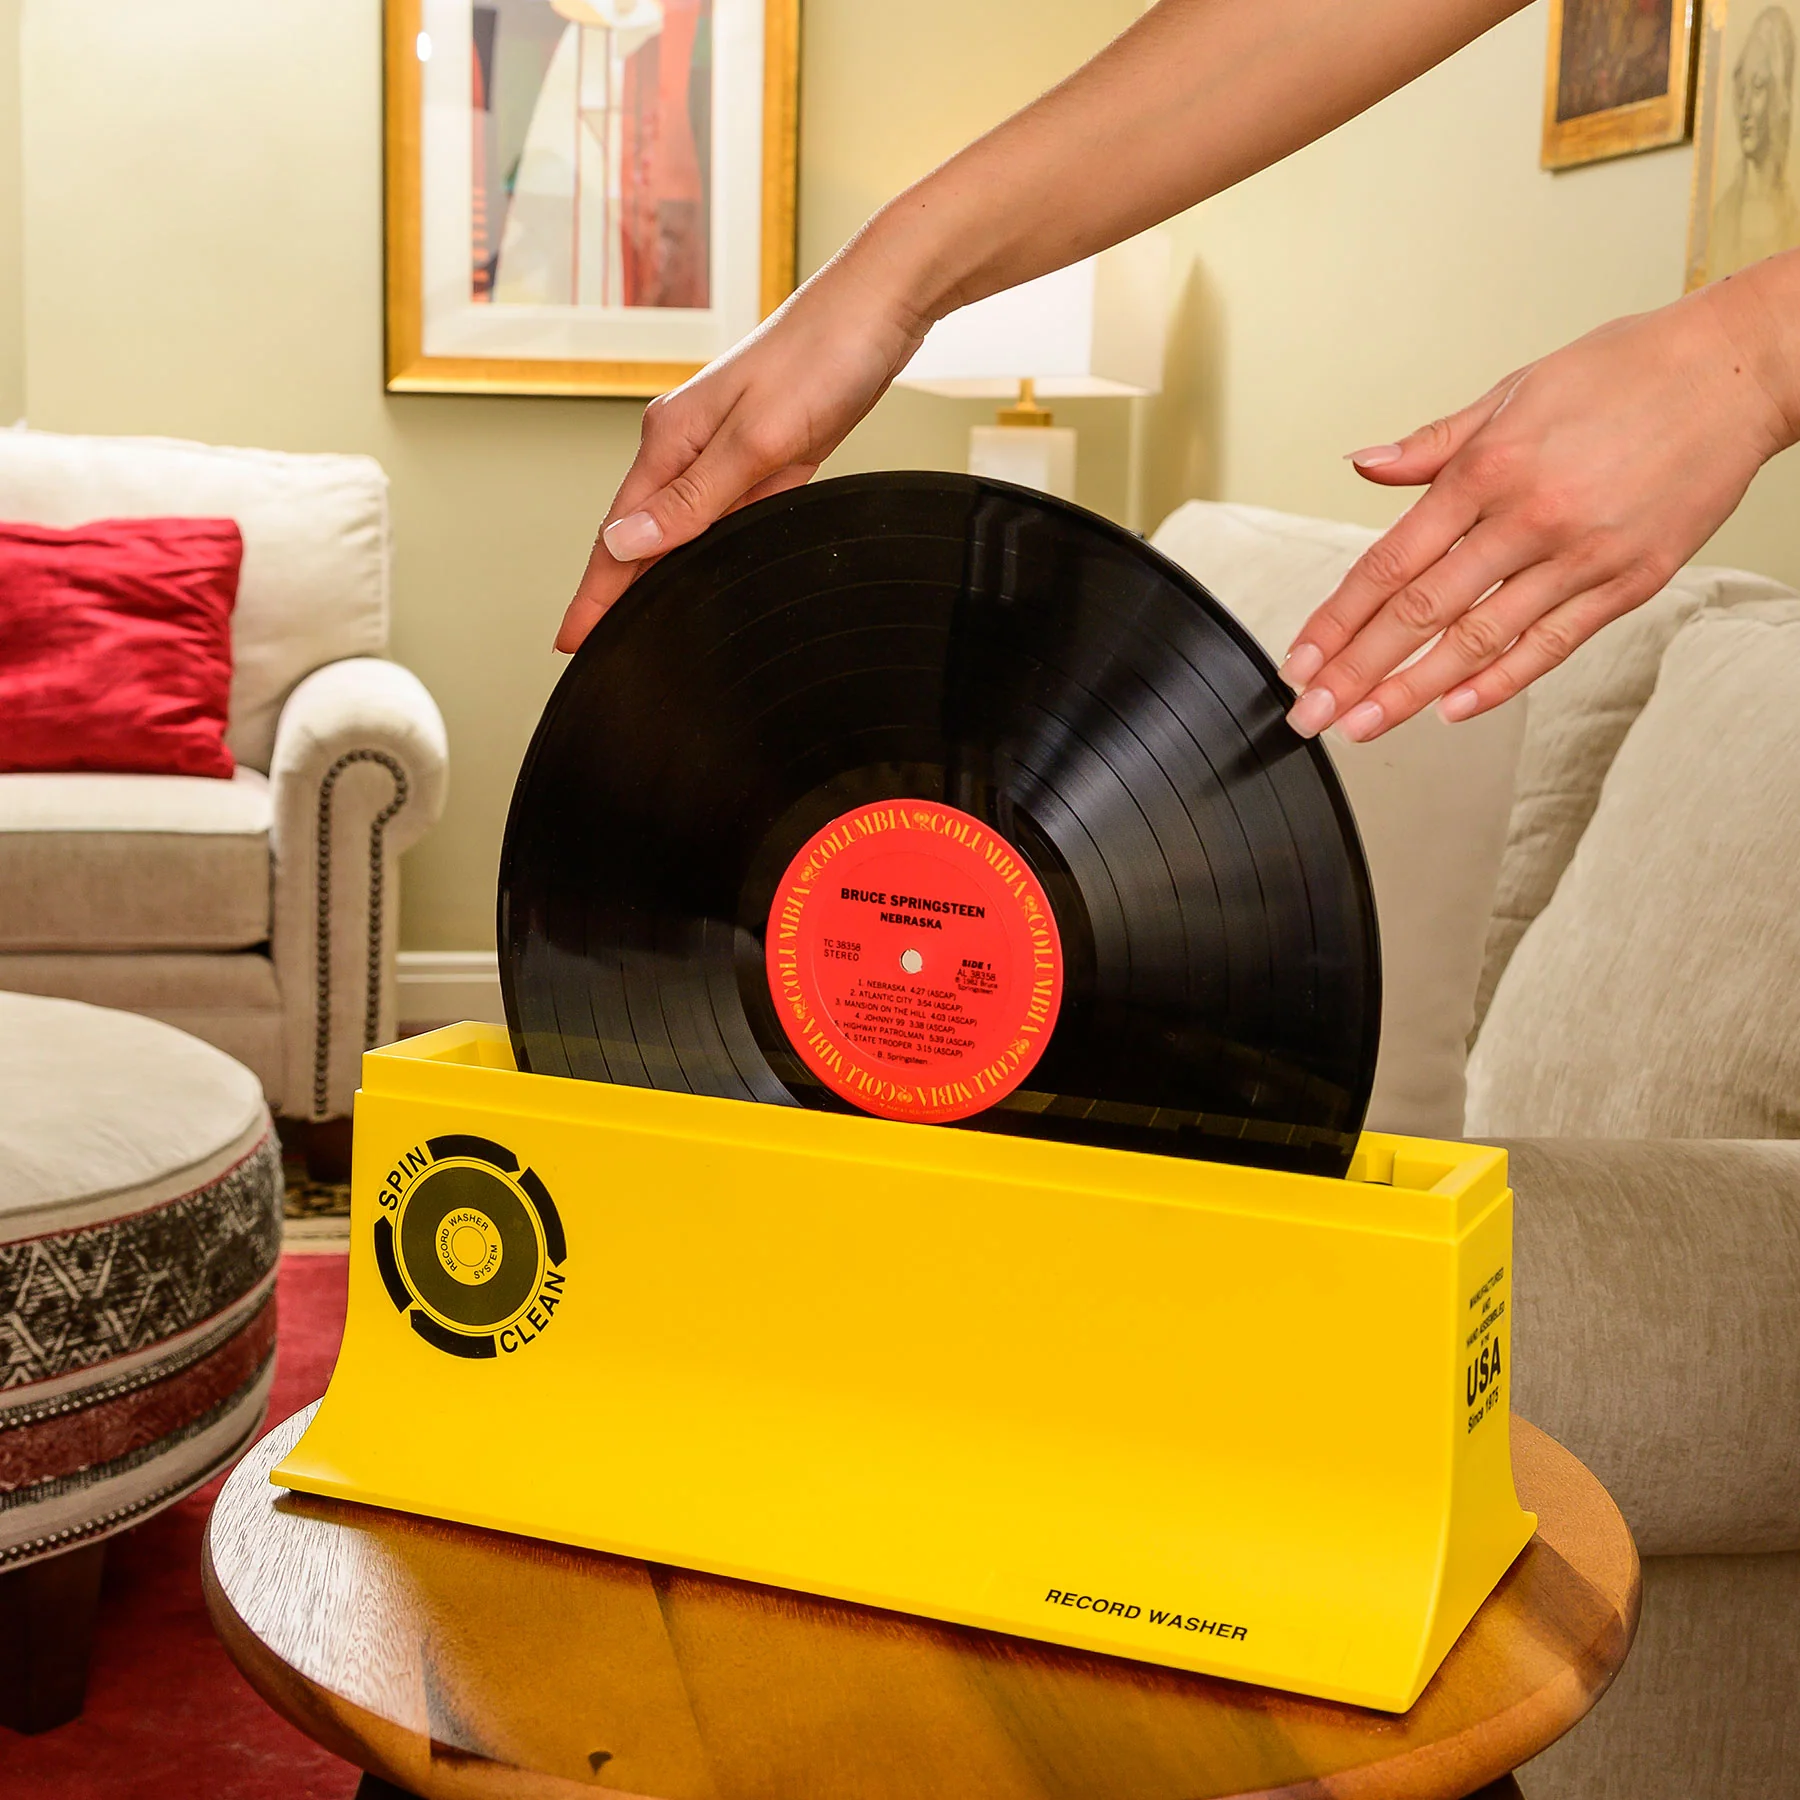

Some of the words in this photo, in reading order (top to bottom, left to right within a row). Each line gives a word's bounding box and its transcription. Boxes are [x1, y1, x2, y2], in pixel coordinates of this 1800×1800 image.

[810, 808, 911, 870] COLUMBIA
[930, 813, 1028, 898] COLUMBIA
[841, 887, 886, 904] BRUCE
[890, 894, 985, 918] SPRINGSTEEN
[880, 912, 942, 930] NEBRASKA
[778, 886, 810, 1002] COLUMBIA
[824, 938, 834, 948] TC
[836, 940, 861, 952] 38358
[824, 949, 860, 962] STEREO
[957, 969, 967, 977] AL
[970, 970, 996, 982] 38358
[962, 959, 984, 969] SIDE
[1020, 914, 1054, 1033] COLUMBIA
[859, 990, 894, 1002] ATLANTIC
[896, 996, 912, 1004] CITY
[933, 1002, 963, 1013] (ASCAP)
[867, 980, 906, 992] NEBRASKA
[927, 990, 956, 1001] (ASCAP)
[844, 1000, 878, 1011] MANSION
[881, 1003, 891, 1012] ON
[894, 1006, 908, 1016] THE
[910, 1009, 926, 1019] HILL
[948, 1015, 977, 1027] (ASCAP)
[864, 1014, 893, 1024] JOHNNY
[896, 1018, 905, 1026] 99
[926, 1023, 956, 1034] (ASCAP)
[843, 1021, 877, 1032] HIGHWAY
[879, 1026, 924, 1040] PATROLMAN
[946, 1038, 975, 1049] (ASCAP)
[854, 1034, 876, 1045] STATE
[879, 1038, 912, 1049] TROOPER
[934, 1047, 963, 1058] (ASCAP)
[802, 1017, 896, 1102] COLUMBIA
[887, 1052, 928, 1065] Springsteen
[916, 1050, 1019, 1106] COLUMBIA
[378, 1146, 428, 1210] SPIN
[448, 1213, 489, 1231] WASHER
[441, 1228, 458, 1272] RECORD
[474, 1244, 498, 1279] SYSTEM
[500, 1271, 566, 1354] CLEAN
[1467, 1336, 1501, 1407] USA
[1468, 1406, 1484, 1434] Since
[1045, 1589, 1141, 1619] RECORD
[1149, 1609, 1248, 1641] WASHER
